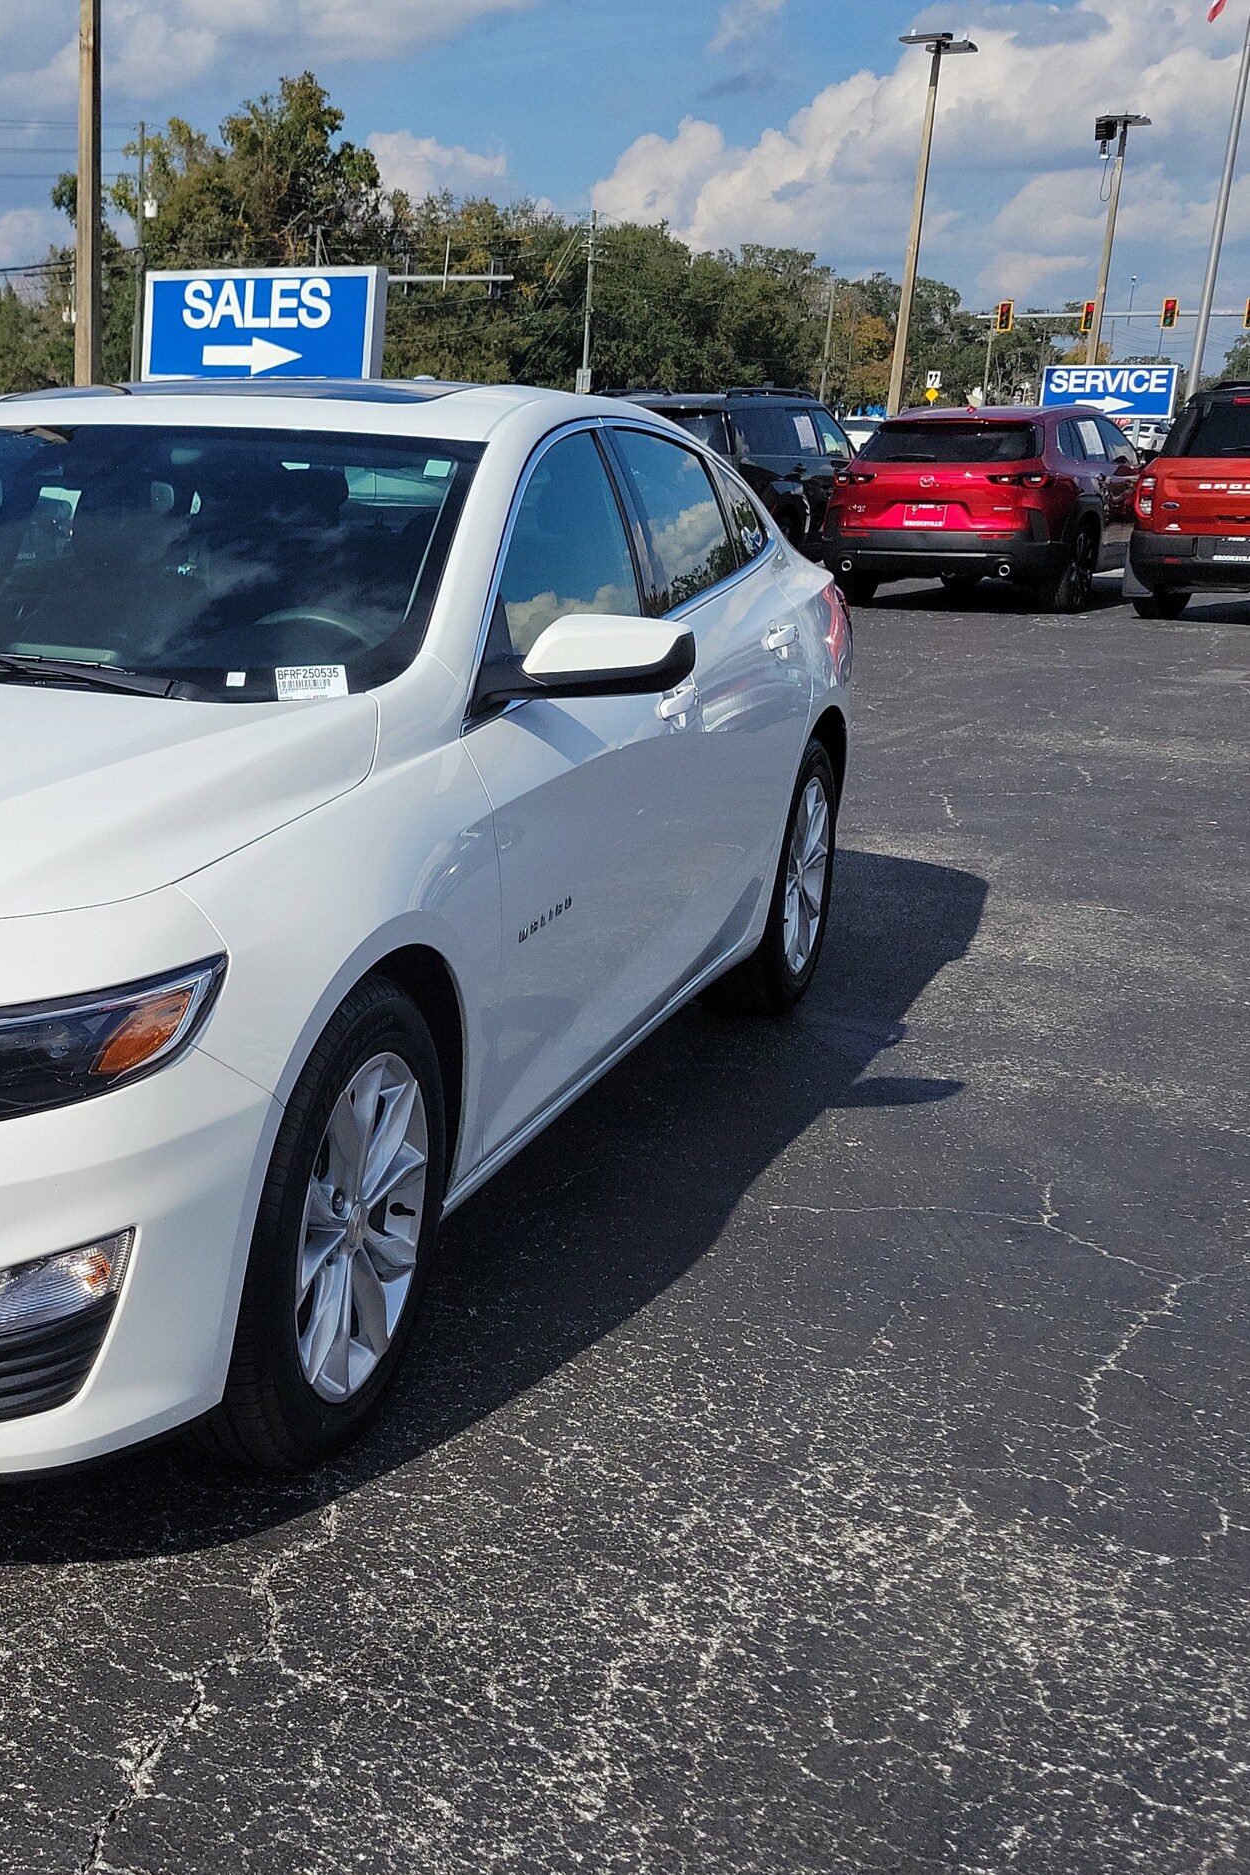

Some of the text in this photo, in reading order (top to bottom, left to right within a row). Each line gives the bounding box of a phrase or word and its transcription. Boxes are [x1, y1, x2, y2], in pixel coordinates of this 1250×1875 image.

[182, 278, 331, 329] SALES
[1050, 370, 1169, 393] SERVICE
[277, 667, 340, 680] BFRF250535
